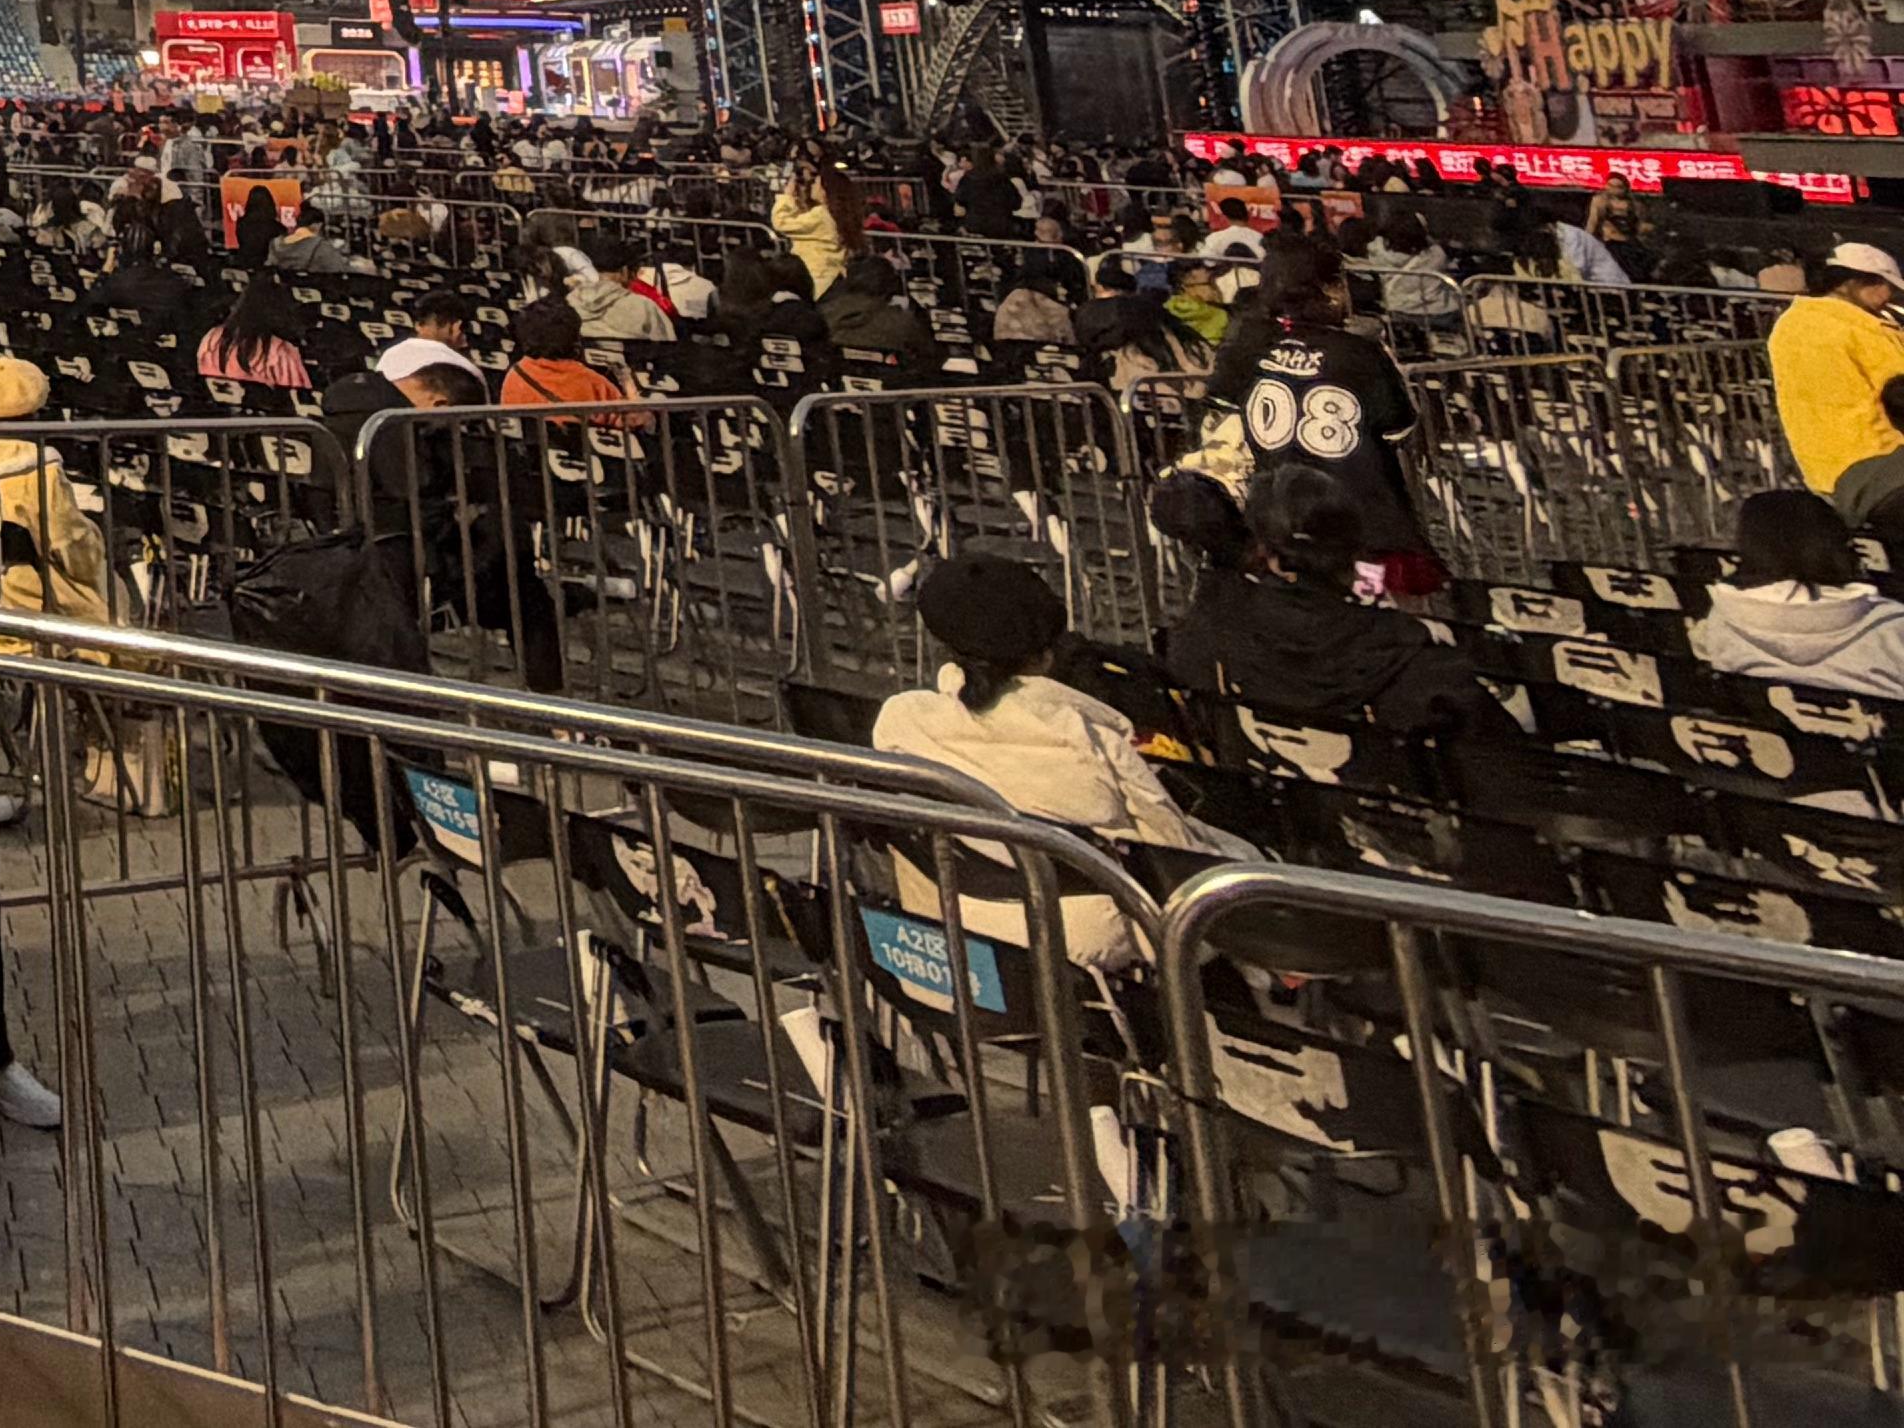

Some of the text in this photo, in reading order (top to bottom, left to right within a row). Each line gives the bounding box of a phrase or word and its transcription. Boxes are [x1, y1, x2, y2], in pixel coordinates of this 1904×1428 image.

[1526, 9, 1674, 90] Happy
[1246, 379, 1362, 458] 08
[896, 925, 949, 962] A2区
